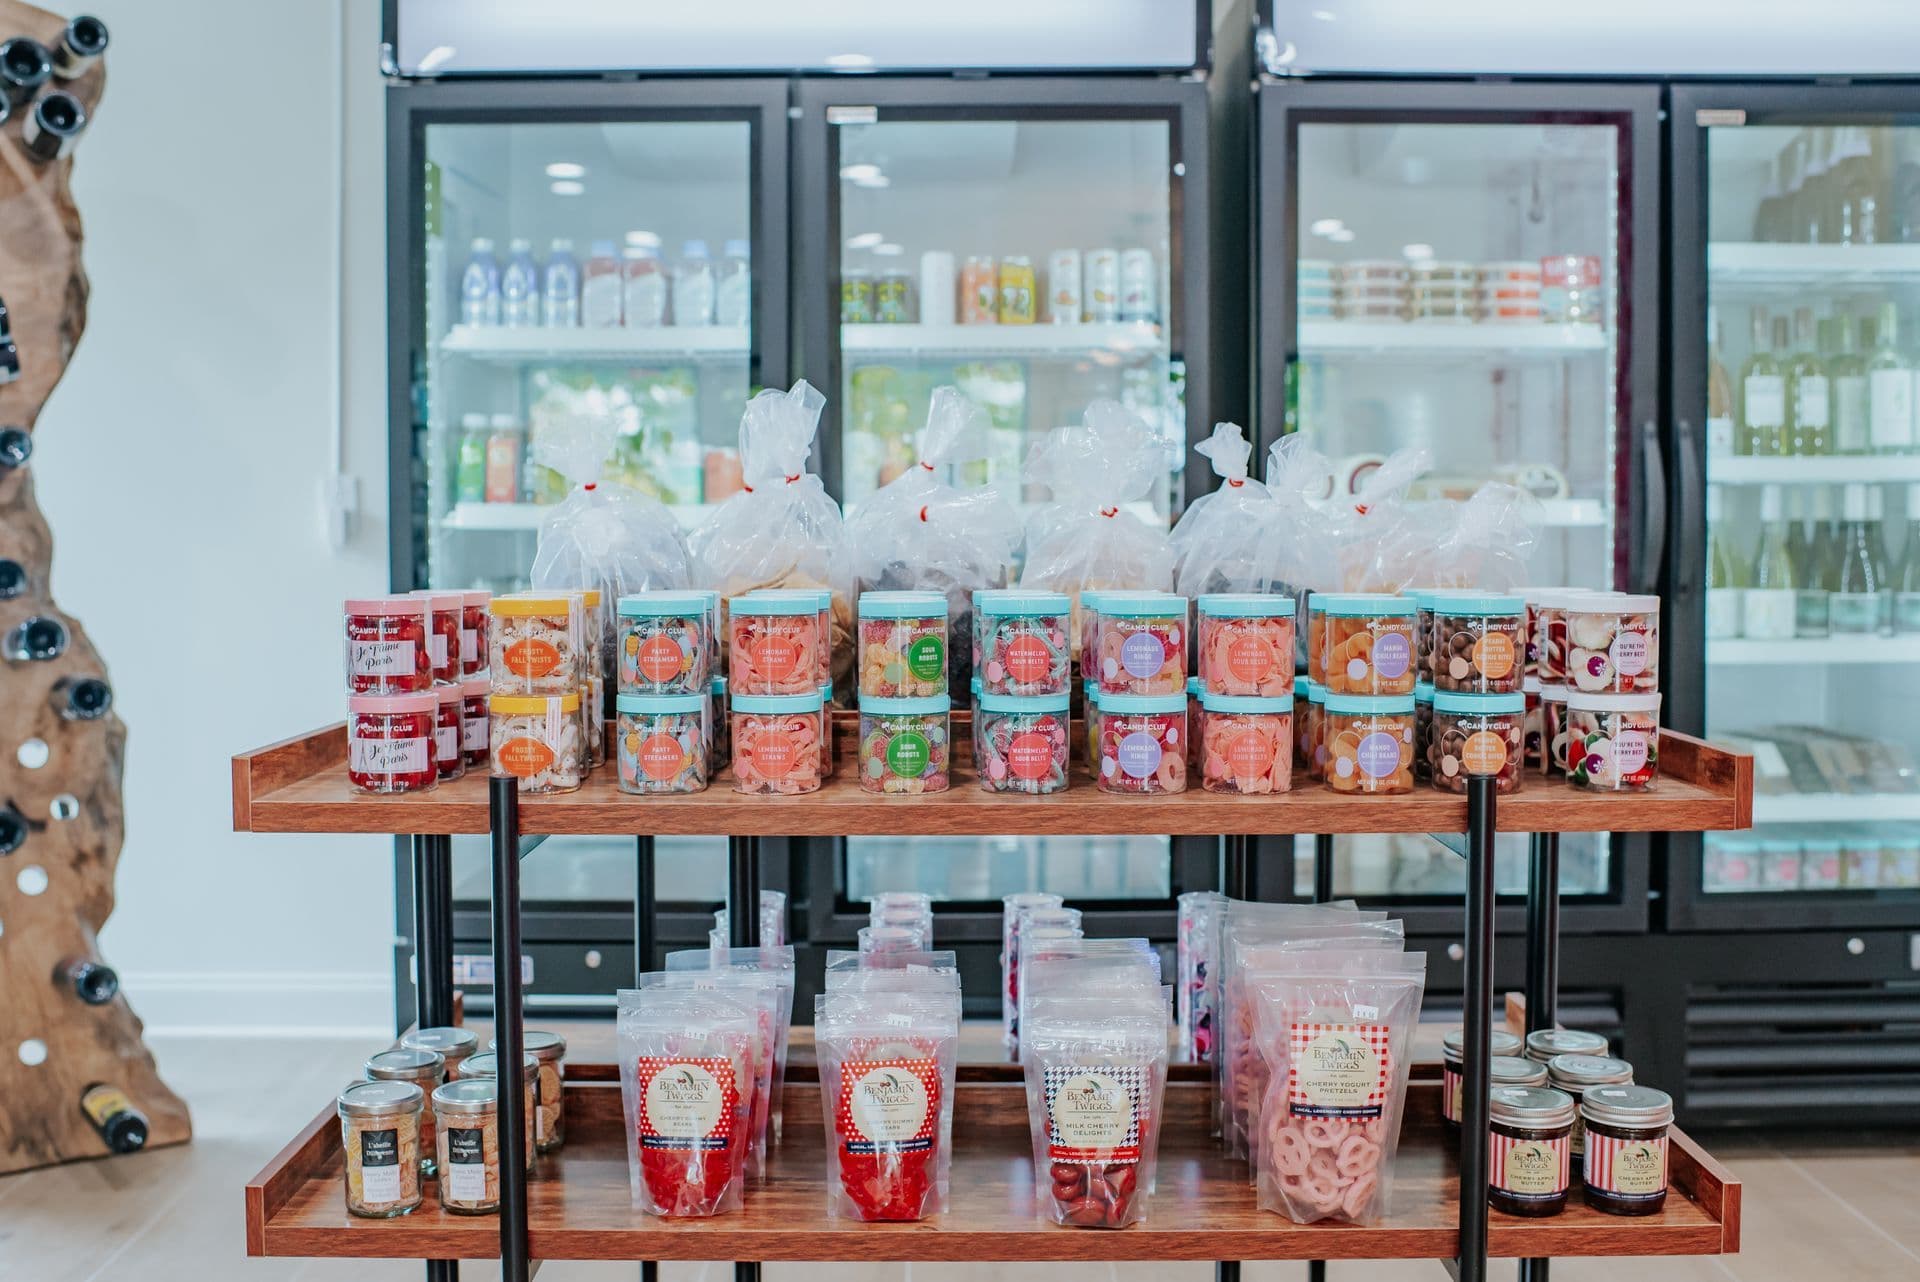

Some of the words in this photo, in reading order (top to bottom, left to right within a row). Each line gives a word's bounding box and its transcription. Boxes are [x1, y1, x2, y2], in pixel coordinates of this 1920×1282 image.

[355, 627, 378, 635] CANDY
[379, 627, 400, 635] LUB
[518, 647, 545, 655] FROSTY
[365, 655, 393, 671] Paris
[511, 656, 526, 664] FALL
[527, 656, 553, 664] TWISTS
[394, 724, 414, 732] CLUB
[1038, 724, 1055, 732] CLUB
[1467, 722, 1493, 730] CANDY
[1493, 722, 1511, 730] CLUB
[512, 745, 537, 753] FROSTY
[1313, 1049, 1366, 1061] BENJAMIN
[1320, 1060, 1360, 1070] TWIGGS
[660, 1080, 710, 1092] BENJAMIN
[1306, 1080, 1338, 1088] CHERRY
[864, 1083, 914, 1097] BENJAMIN
[1319, 1087, 1358, 1095] PRETZELS
[665, 1090, 703, 1101] TWIGGS
[871, 1095, 909, 1104] TWIGGS
[1074, 1101, 1113, 1111] TWIGGS
[1514, 1153, 1552, 1163] BENJAMIN
[1623, 1153, 1659, 1163] BENJAMIN
[1520, 1161, 1548, 1169] TWIGGS
[1628, 1161, 1655, 1169] TWIGGS
